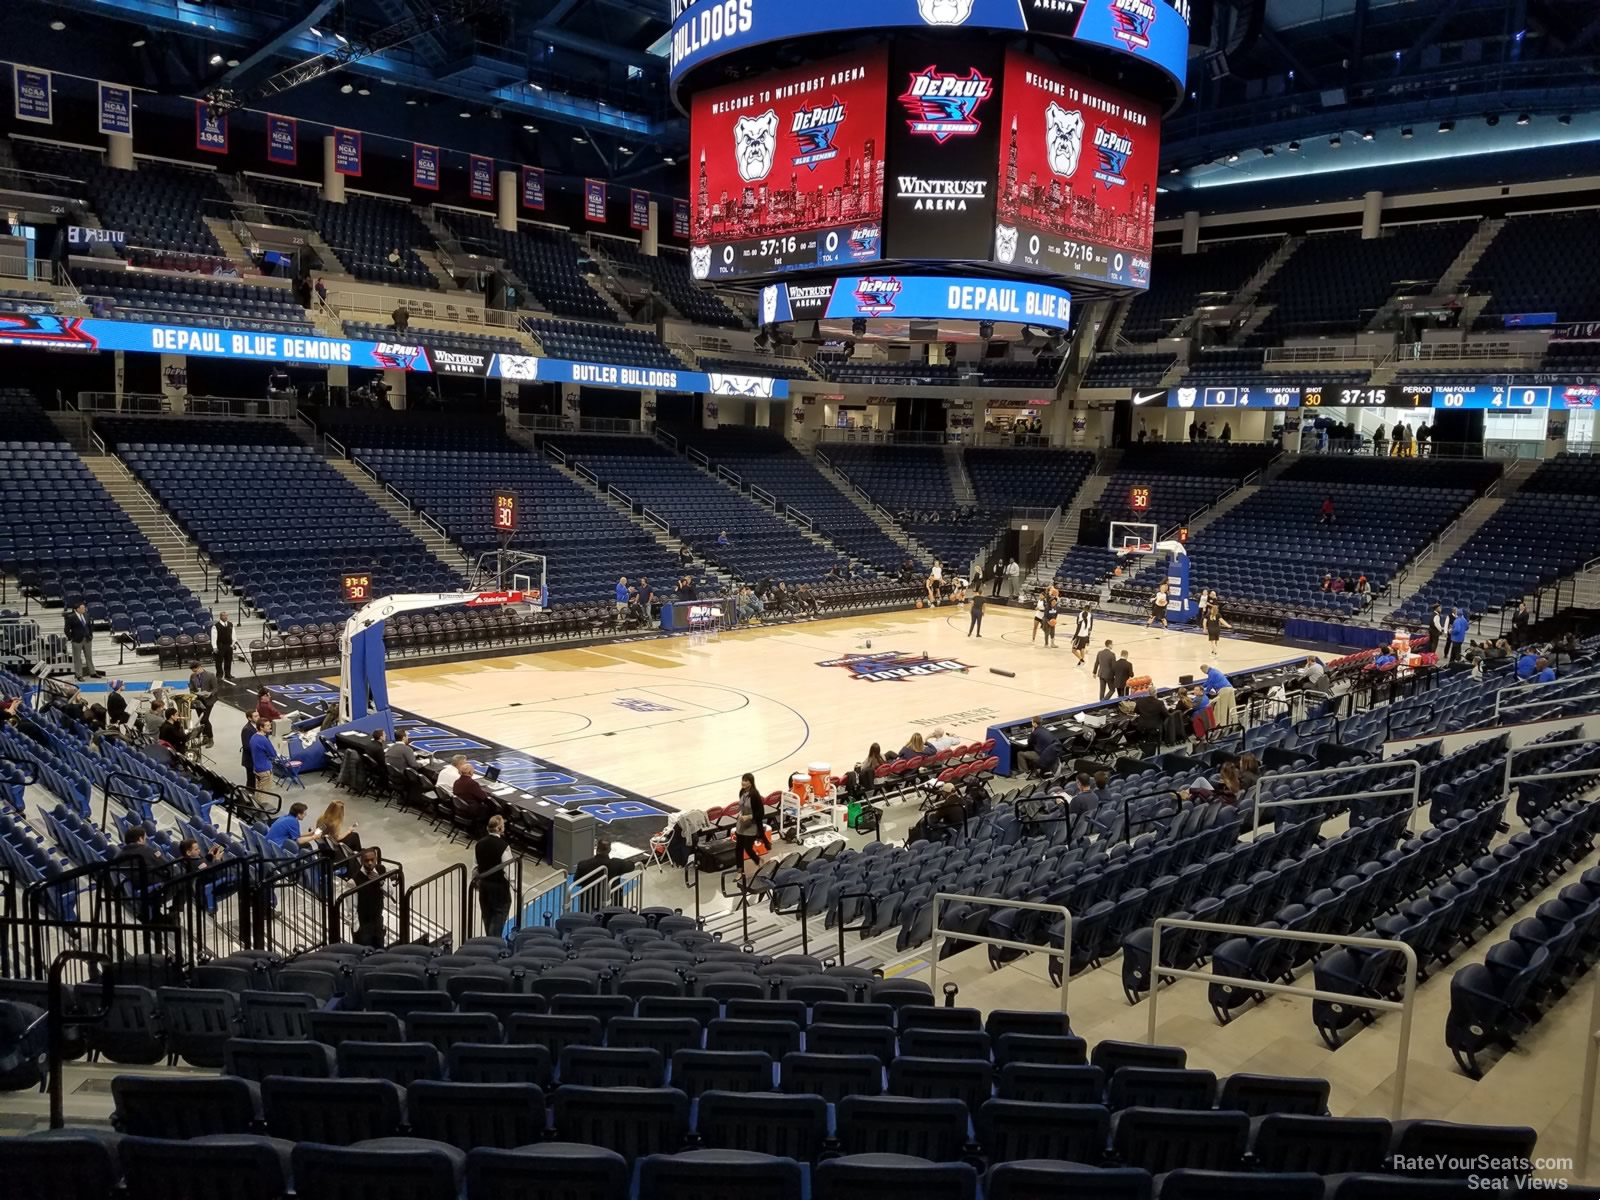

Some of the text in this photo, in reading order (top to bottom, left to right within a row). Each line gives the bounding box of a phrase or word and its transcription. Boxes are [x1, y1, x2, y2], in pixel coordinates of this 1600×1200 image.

[1034, 0, 1073, 13] ARENA
[1115, 0, 1154, 20] DEPAUL
[673, 0, 753, 67] BULLDOGS
[21, 86, 45, 97] NCAA
[712, 66, 865, 115] WELCOME TO WINTRUST ARENA
[911, 76, 987, 97] DEPAUL
[1025, 71, 1147, 126] WELCOME TO WINTRUST ARENA
[104, 102, 126, 112] NCAA
[792, 104, 844, 132] DEPAUL
[200, 132, 224, 143] 1945
[272, 133, 291, 141] NCAA
[1094, 129, 1132, 156] DEPAUL
[339, 145, 356, 154] NCAA
[419, 160, 435, 168] NCAA
[898, 177, 987, 194] WINTRUST
[51, 205, 64, 213] 224
[914, 199, 967, 211] ARENA
[852, 227, 879, 240] DEPAUL
[760, 237, 796, 256] 37:16
[826, 231, 838, 252] 0
[1029, 235, 1040, 255] 0
[723, 246, 734, 264] 0
[1063, 241, 1093, 261] 37:16
[822, 255, 833, 263] TOL
[1025, 256, 1033, 265] TOL
[1114, 253, 1123, 271] 0
[719, 265, 735, 274] TOL 4
[789, 285, 832, 297] WINTRUST
[858, 280, 901, 292] DEPAUL
[796, 298, 821, 307] ARENA
[948, 285, 1020, 313] DEPAUL
[1025, 291, 1056, 318] BLUE
[152, 328, 351, 361] DEPAUL BLUE DEMONS
[377, 343, 420, 356] DEPAUL
[435, 351, 484, 365] WINTRUST
[445, 364, 475, 373] ARENA
[572, 365, 677, 388] BUTLER BULLDOGS
[1216, 391, 1225, 404] 0
[1240, 393, 1249, 405] 4
[1275, 394, 1289, 406] 00
[1305, 394, 1321, 406] 30
[1341, 389, 1385, 404] 37:15
[1413, 394, 1420, 406] 1
[1444, 394, 1463, 406] 00
[1492, 394, 1502, 406] 4
[1523, 390, 1535, 405] 0
[1134, 496, 1146, 506] 30
[500, 509, 512, 526] 30
[345, 577, 368, 587] 37:15
[350, 587, 364, 598] 30
[857, 660, 966, 682] DEPAUL
[908, 707, 995, 727] WINTRUST
[950, 715, 998, 727] ARENA
